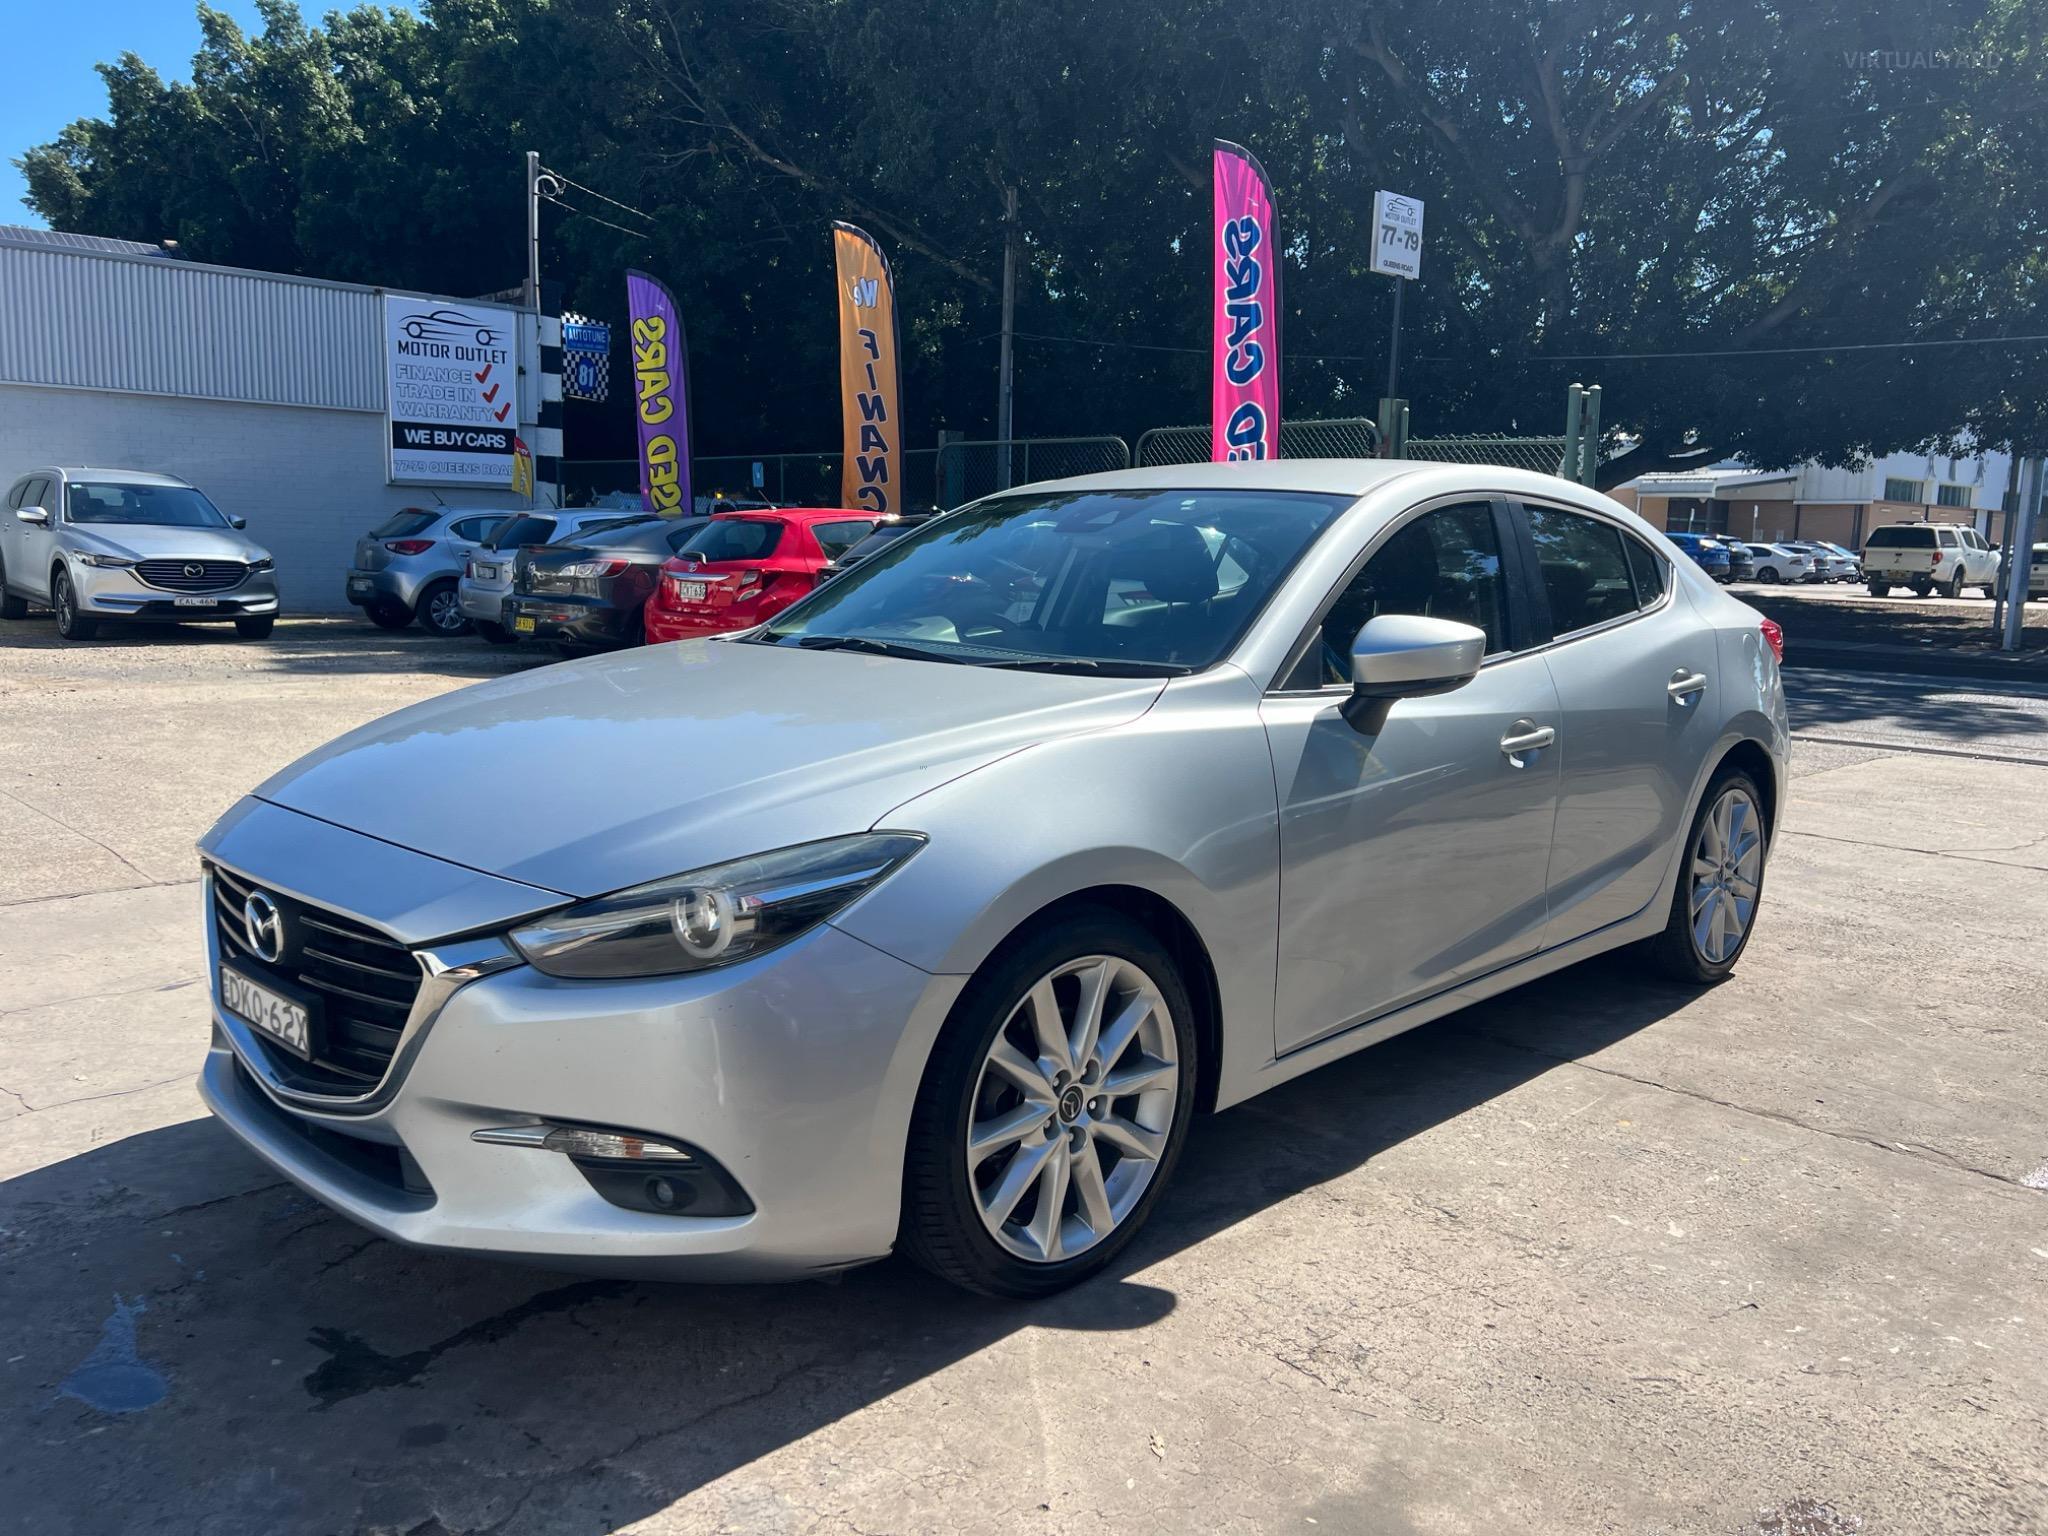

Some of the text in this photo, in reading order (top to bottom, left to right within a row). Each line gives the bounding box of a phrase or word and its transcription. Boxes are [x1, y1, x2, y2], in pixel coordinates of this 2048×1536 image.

[1385, 212, 1416, 225] MOTOR OUTLET
[568, 327, 606, 343] AUTOTUNE
[398, 340, 508, 364] MOTOR OUTLET
[396, 363, 472, 385] FINANCE
[579, 364, 595, 388] 81
[396, 382, 476, 403] TRADE IN
[397, 400, 495, 422] WARRANTY
[404, 429, 507, 449] WE BUY CARS
[395, 460, 427, 472] 77-79
[429, 461, 480, 474] QUEENS
